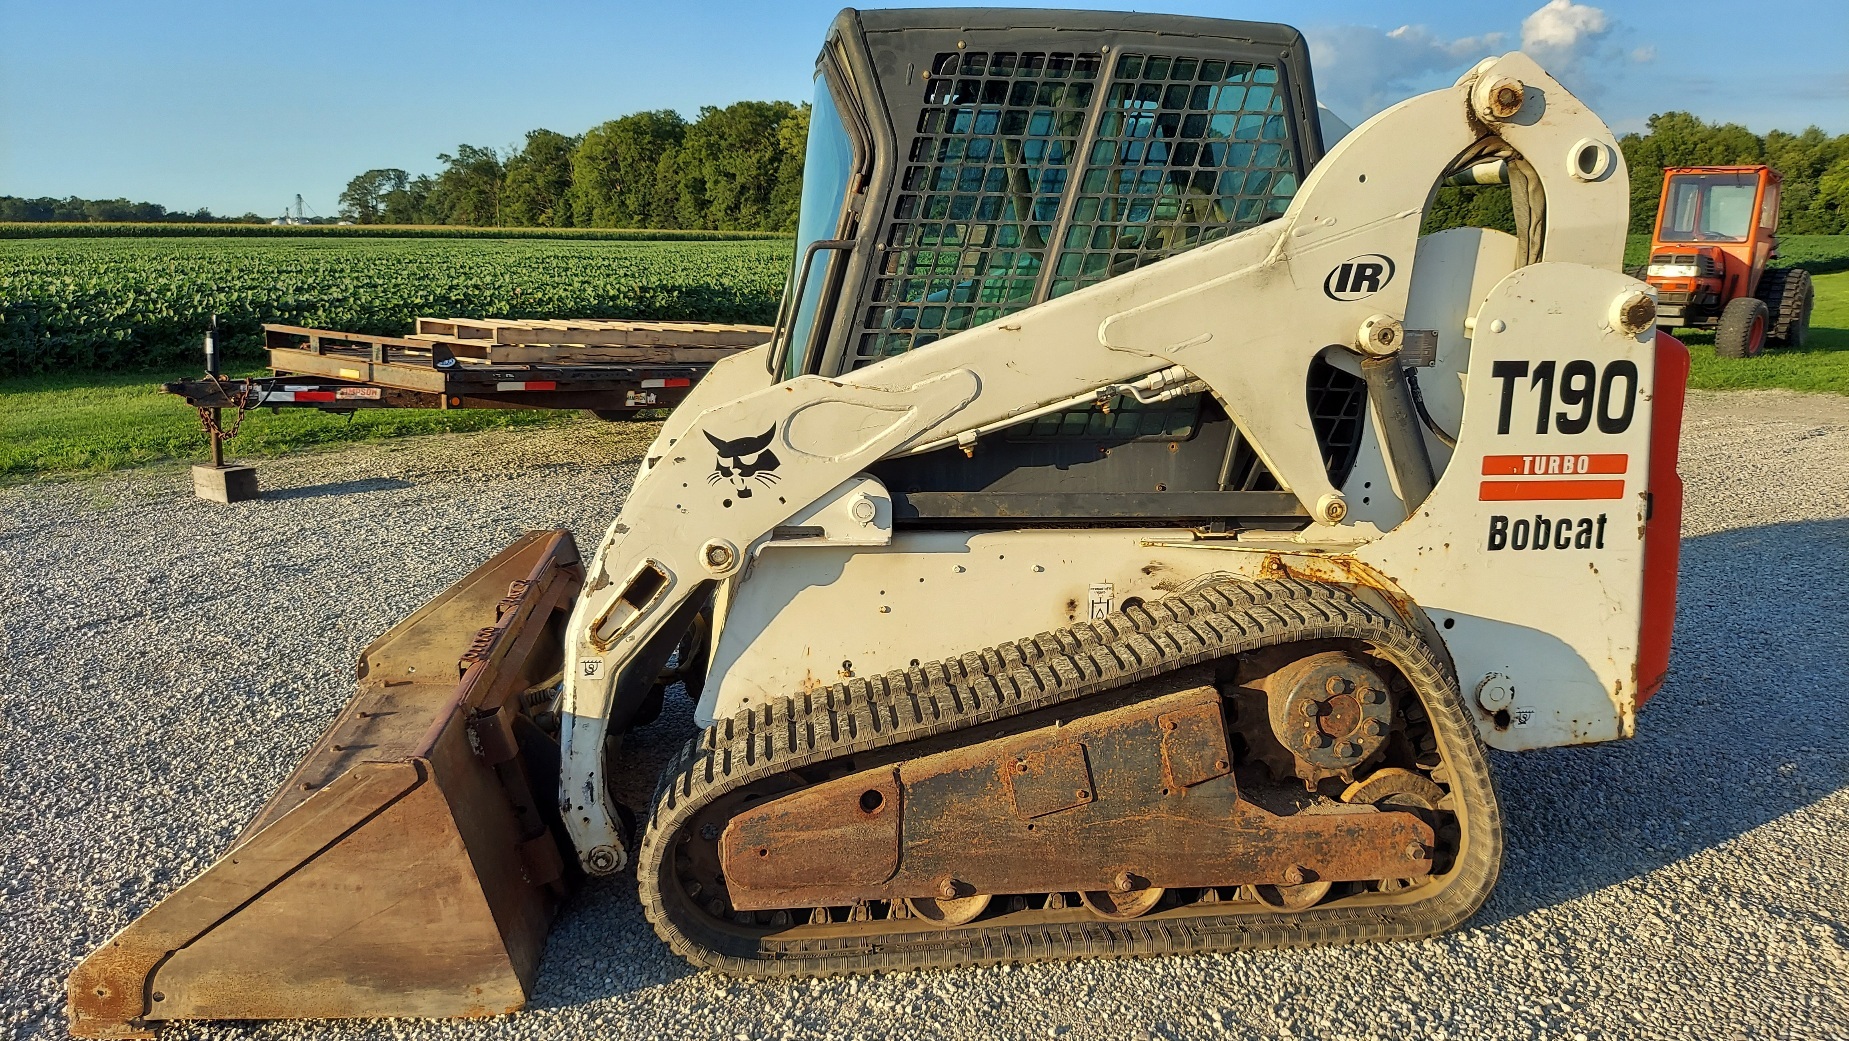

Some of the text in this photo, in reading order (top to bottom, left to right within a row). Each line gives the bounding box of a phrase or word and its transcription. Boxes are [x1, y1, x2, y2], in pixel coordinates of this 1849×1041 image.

[1336, 264, 1383, 293] IR
[1492, 359, 1638, 435] T190
[1523, 456, 1590, 475] TURBO
[1487, 513, 1607, 551] Bobcat
